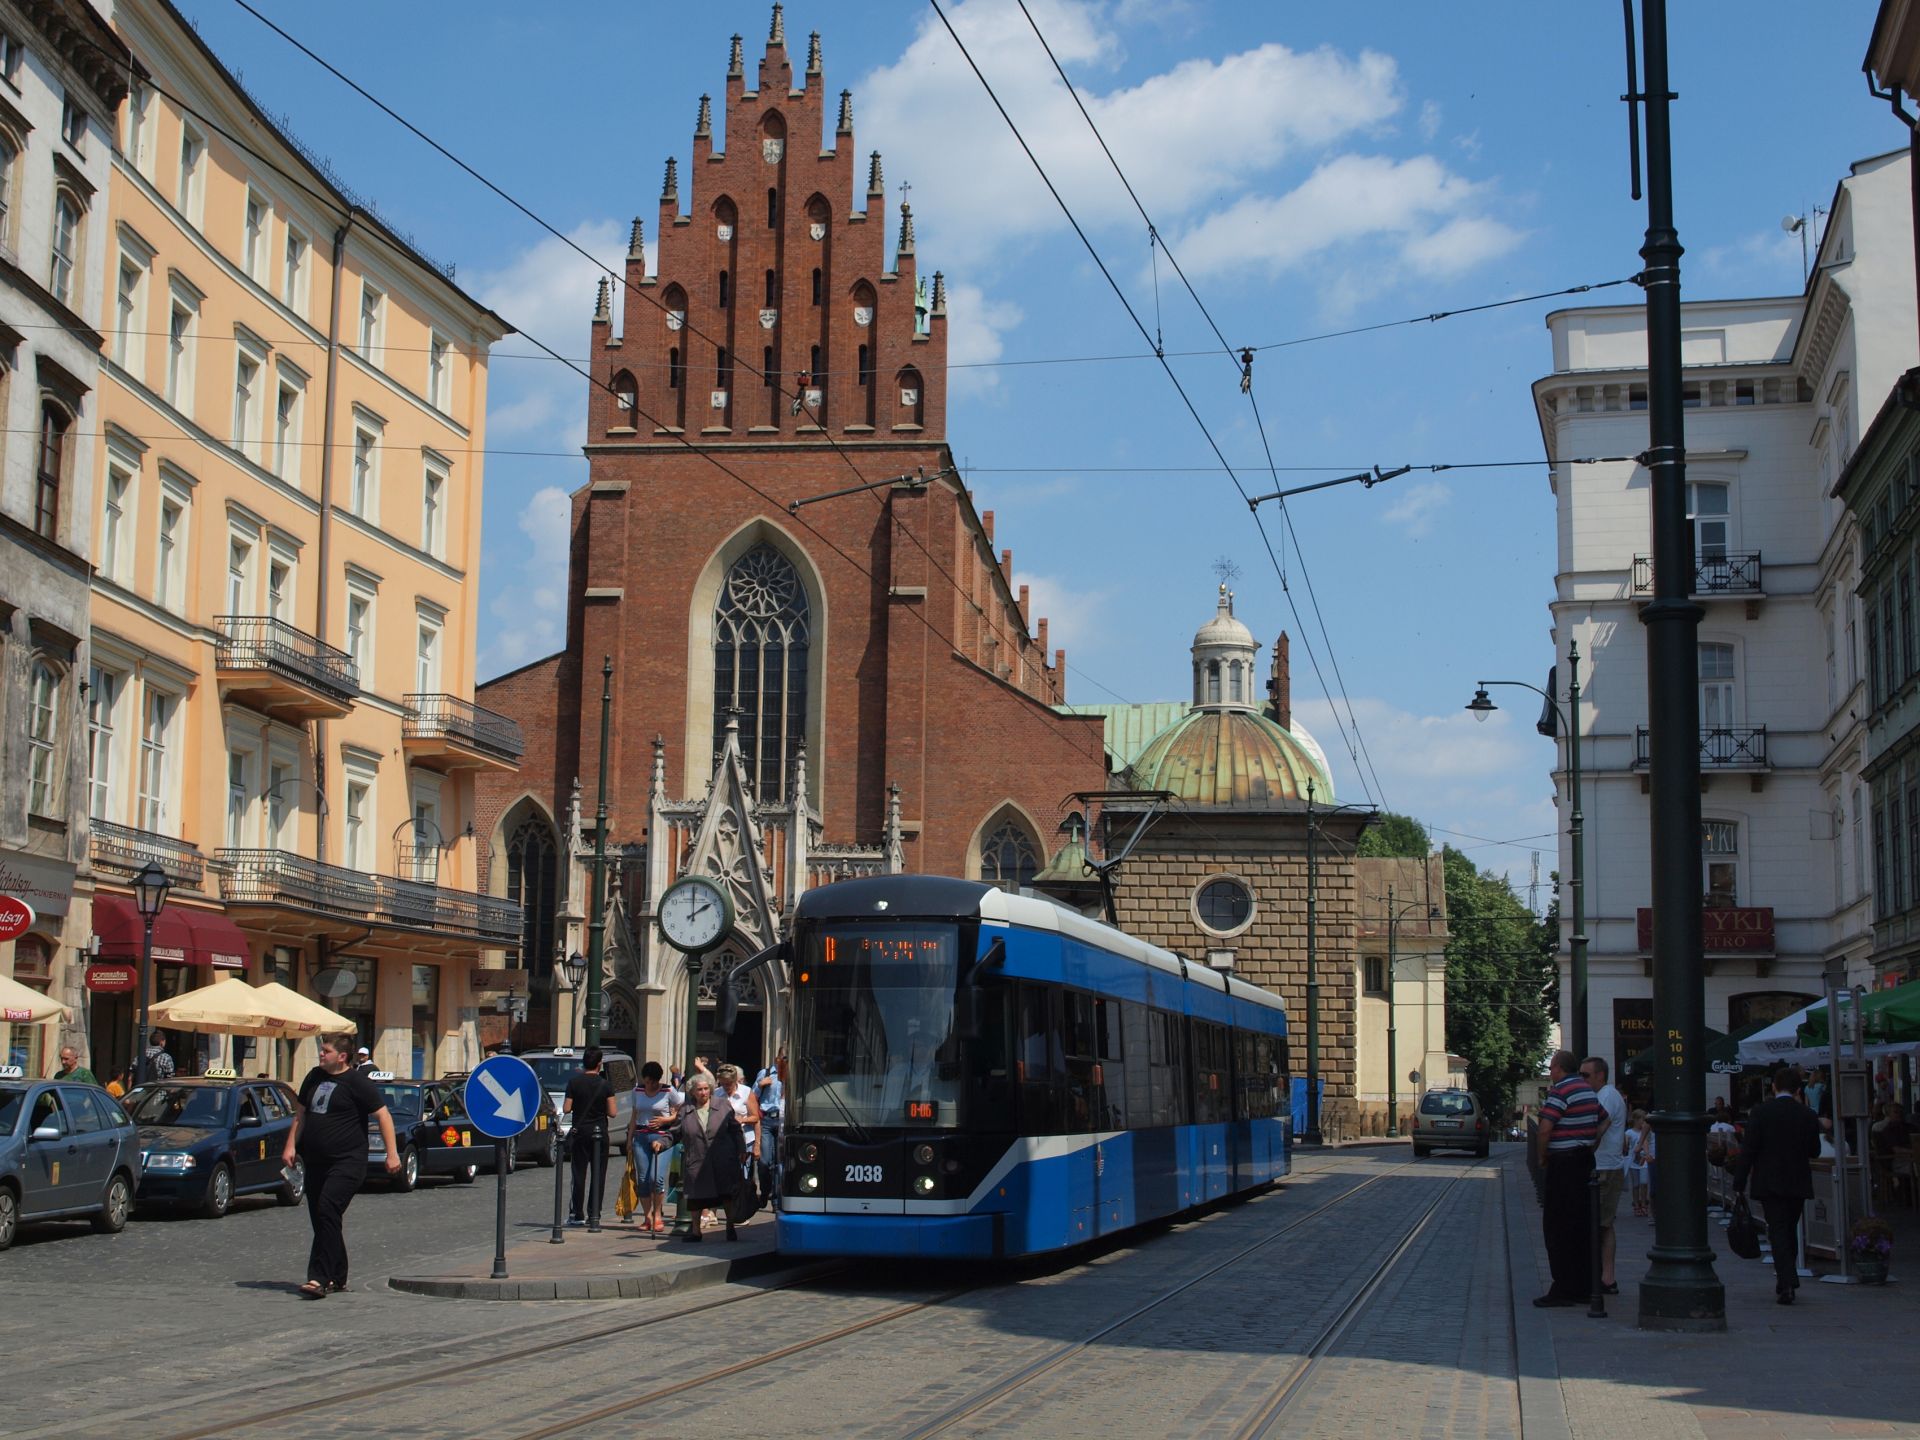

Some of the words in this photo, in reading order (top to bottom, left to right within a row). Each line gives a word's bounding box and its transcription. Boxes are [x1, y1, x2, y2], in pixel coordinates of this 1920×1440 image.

[33, 888, 67, 901] CUKIERNIA
[1668, 1030, 1683, 1039] PL
[1670, 1043, 1683, 1053] 10
[1670, 1056, 1683, 1065] 19
[1711, 1060, 1743, 1073] Carlsberg
[845, 1165, 883, 1183] 2038
